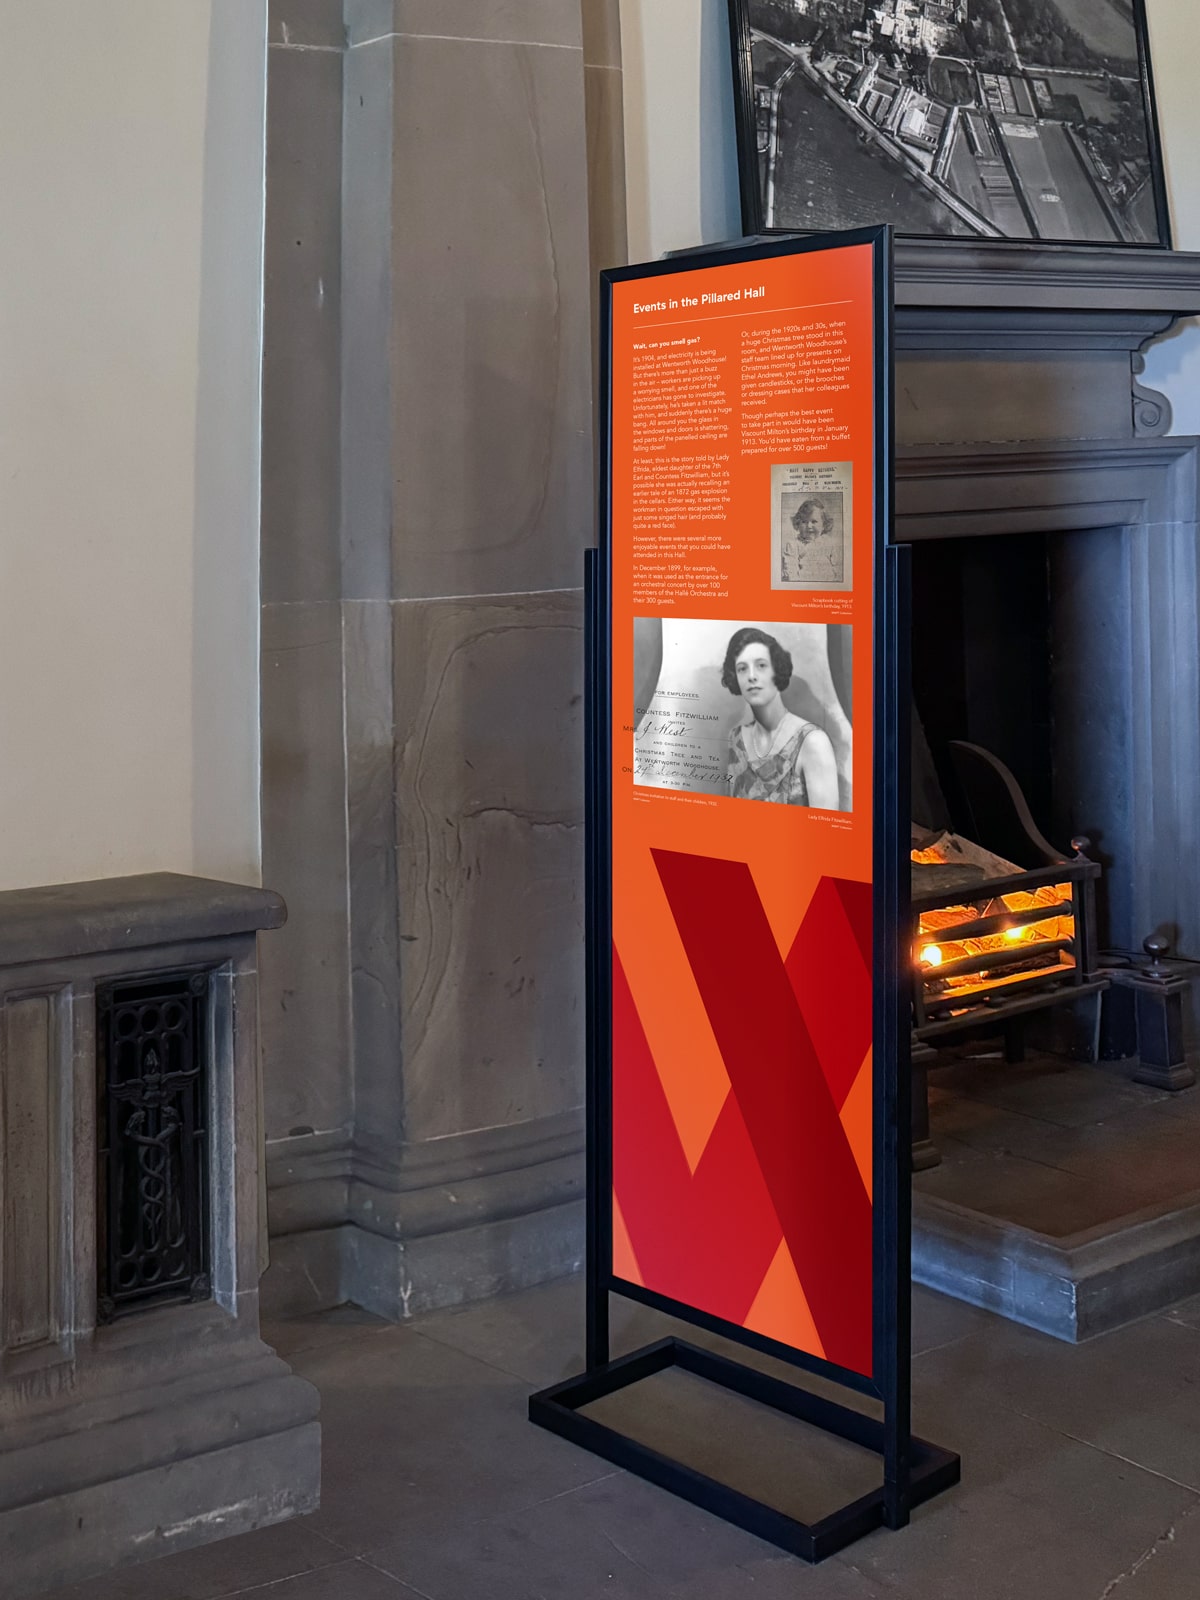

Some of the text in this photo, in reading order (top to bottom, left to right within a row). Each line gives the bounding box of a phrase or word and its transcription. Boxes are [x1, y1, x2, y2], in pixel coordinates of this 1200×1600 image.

[633, 286, 765, 313] Events in the Pillared Hall
